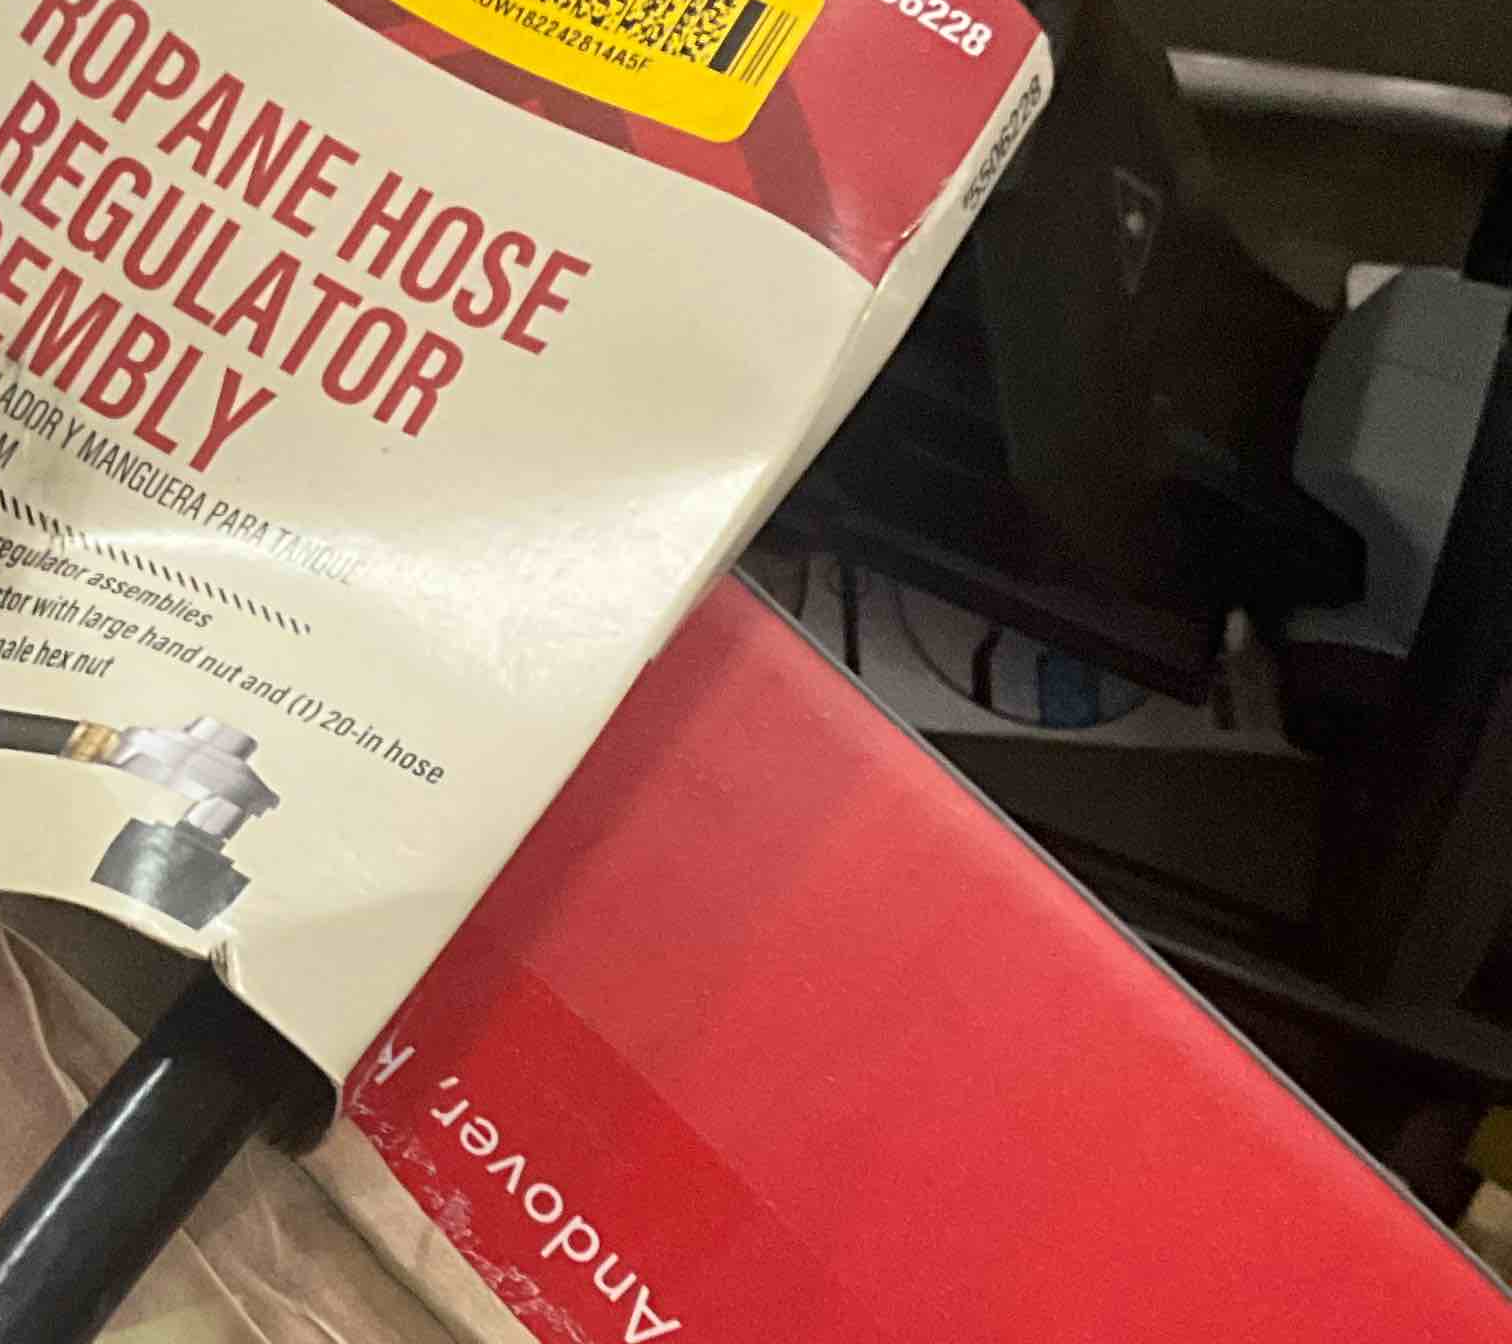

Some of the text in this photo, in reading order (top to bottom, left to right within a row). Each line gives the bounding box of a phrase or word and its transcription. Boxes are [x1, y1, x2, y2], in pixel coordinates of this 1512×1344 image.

[961, 73, 1042, 218] #5506228
[336, 171, 591, 356] HOSE
[60, 416, 85, 448] Y
[74, 429, 207, 520] MANGUERA
[201, 496, 272, 544] PARA
[31, 636, 76, 674] hex
[70, 645, 118, 683] nut
[85, 572, 213, 628] assemblies
[30, 596, 80, 623] with
[77, 603, 139, 640] large
[139, 625, 203, 664] hand
[198, 655, 243, 683] nut
[239, 675, 291, 705] and
[286, 693, 323, 723] (1)
[318, 710, 384, 753] 20-in
[382, 738, 445, 785] hose
[430, 1075, 681, 1344] Andover,
